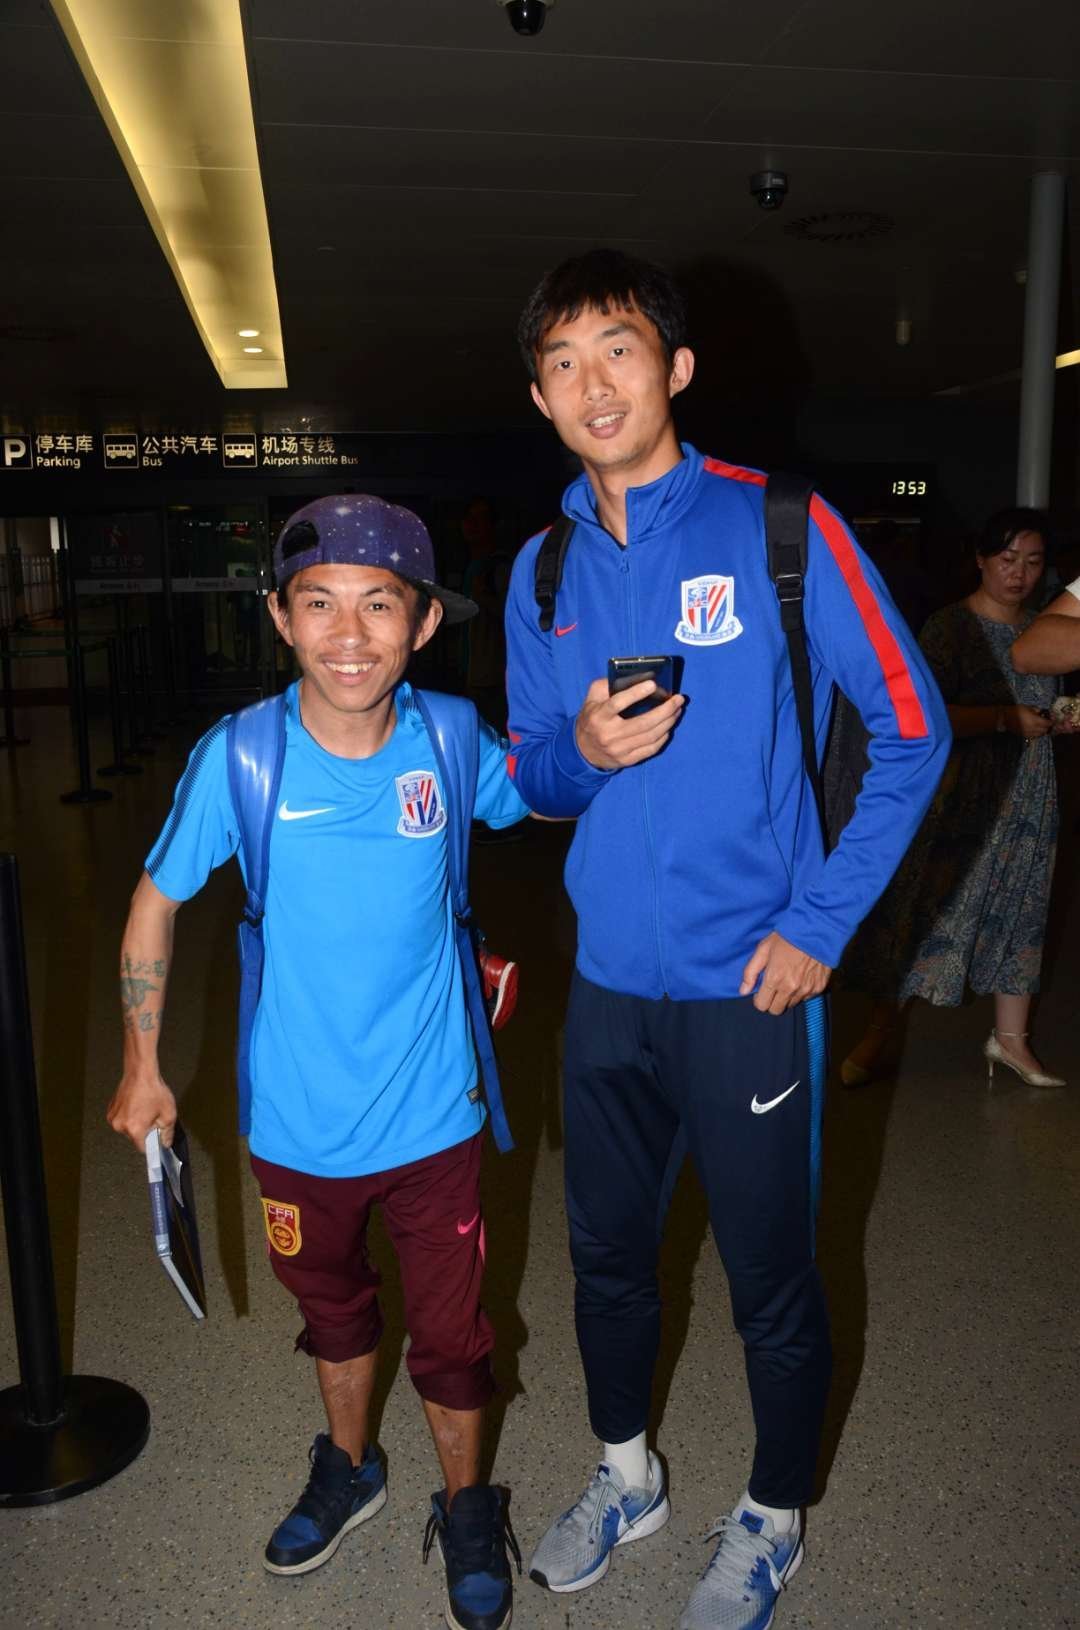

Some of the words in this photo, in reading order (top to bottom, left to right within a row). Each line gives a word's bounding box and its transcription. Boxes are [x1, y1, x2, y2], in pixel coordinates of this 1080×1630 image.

[4, 439, 26, 466] P
[36, 434, 94, 454] 停车库
[142, 435, 218, 455] 公共汽车
[261, 435, 336, 454] 机场专线
[36, 456, 81, 469] Parking
[142, 456, 163, 467] Bus
[262, 455, 300, 467] Airport
[302, 455, 338, 465] Shuttle
[341, 455, 360, 465] Bus
